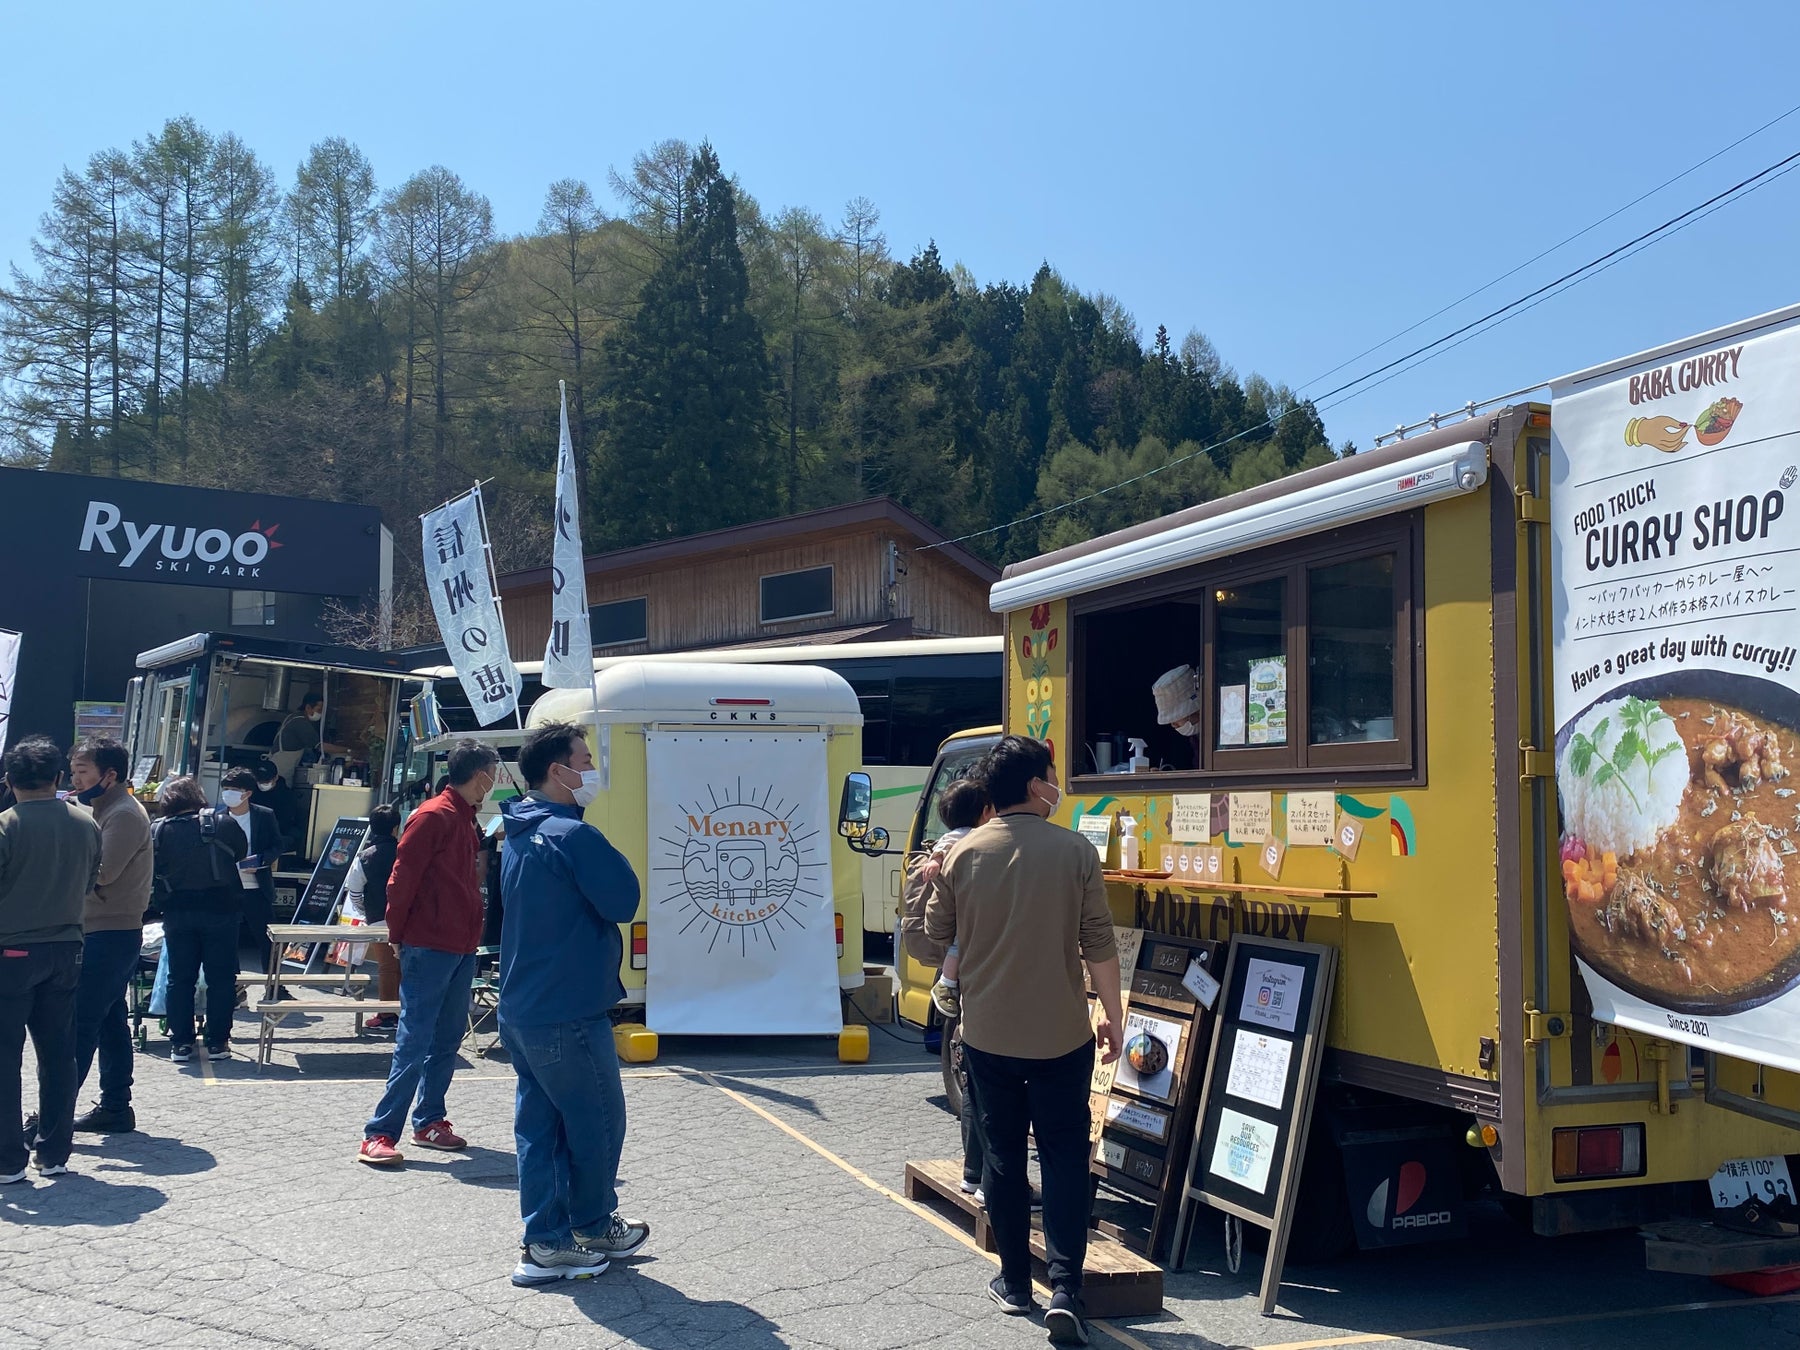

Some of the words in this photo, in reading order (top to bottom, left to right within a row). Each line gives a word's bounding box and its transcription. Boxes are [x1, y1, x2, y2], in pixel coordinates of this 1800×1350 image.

[1629, 366, 1676, 405] BABA
[1678, 346, 1744, 392] CURRY
[1574, 502, 1605, 536] FOOD
[1608, 479, 1656, 517] TRUCK
[78, 501, 269, 568] Ryuoo
[1585, 511, 1683, 572] CURRY
[1692, 489, 1784, 551] SHOP
[155, 560, 190, 572] SKI
[208, 564, 260, 578] PARK
[1571, 663, 1600, 693] Have
[1604, 658, 1613, 674] a
[1616, 642, 1656, 675] great
[1660, 637, 1686, 662] day
[1690, 633, 1727, 657] with
[1732, 641, 1797, 673] curry!!
[687, 813, 792, 842] Menary
[710, 902, 778, 922] kitchen
[1141, 980, 1182, 999] ラムカレー
[1667, 1013, 1690, 1033] Since
[1690, 1019, 1710, 1038] 2021
[1240, 1130, 1252, 1141] OUR
[1241, 1122, 1256, 1134] SAVE
[1230, 1134, 1260, 1153] RESOURCES
[1392, 1211, 1451, 1230] PABCO
